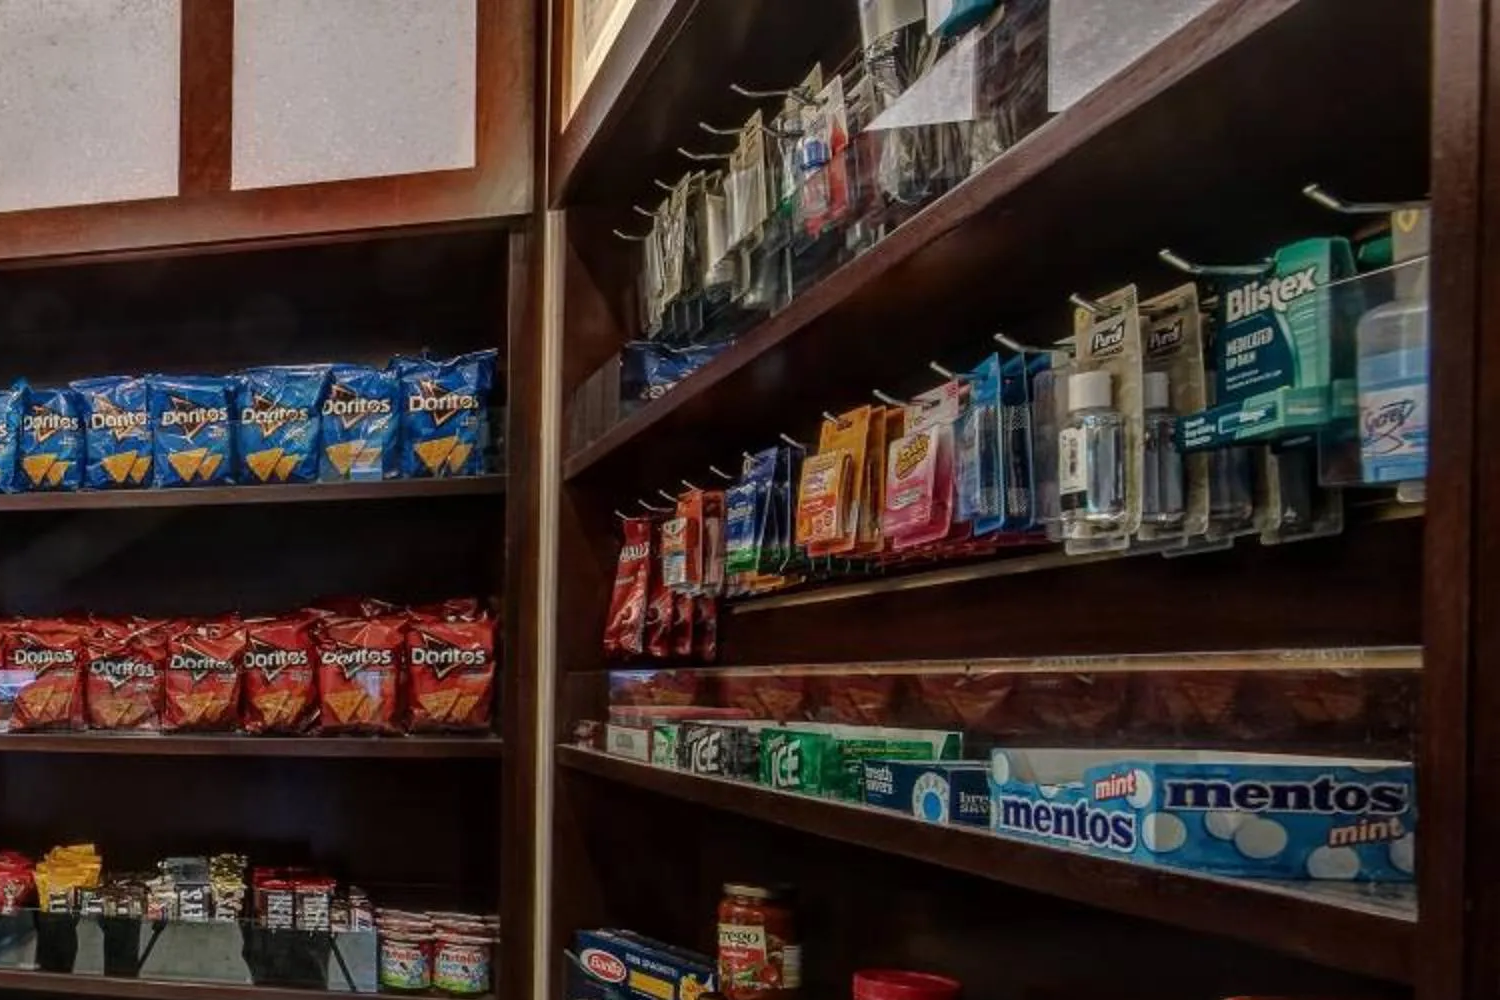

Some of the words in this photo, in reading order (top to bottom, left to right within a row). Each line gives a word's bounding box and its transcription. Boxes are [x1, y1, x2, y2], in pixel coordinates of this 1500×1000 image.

[1226, 265, 1317, 324] Blistex
[322, 398, 391, 416] Doritos
[409, 393, 479, 412] Doritos
[23, 413, 79, 431] Doritos
[161, 406, 228, 425] Doritos
[241, 406, 309, 424] Doritos
[14, 648, 76, 665] Doritos
[170, 653, 234, 672] Doritos
[243, 649, 308, 667] Doritos
[321, 647, 392, 665] Doritos
[411, 647, 485, 665] Doritos
[90, 659, 155, 677] Doritos
[1093, 770, 1137, 801] mint
[1164, 774, 1409, 815] mentos
[1001, 796, 1137, 853] mentos
[1328, 816, 1403, 847] mint
[718, 930, 760, 945] rego
